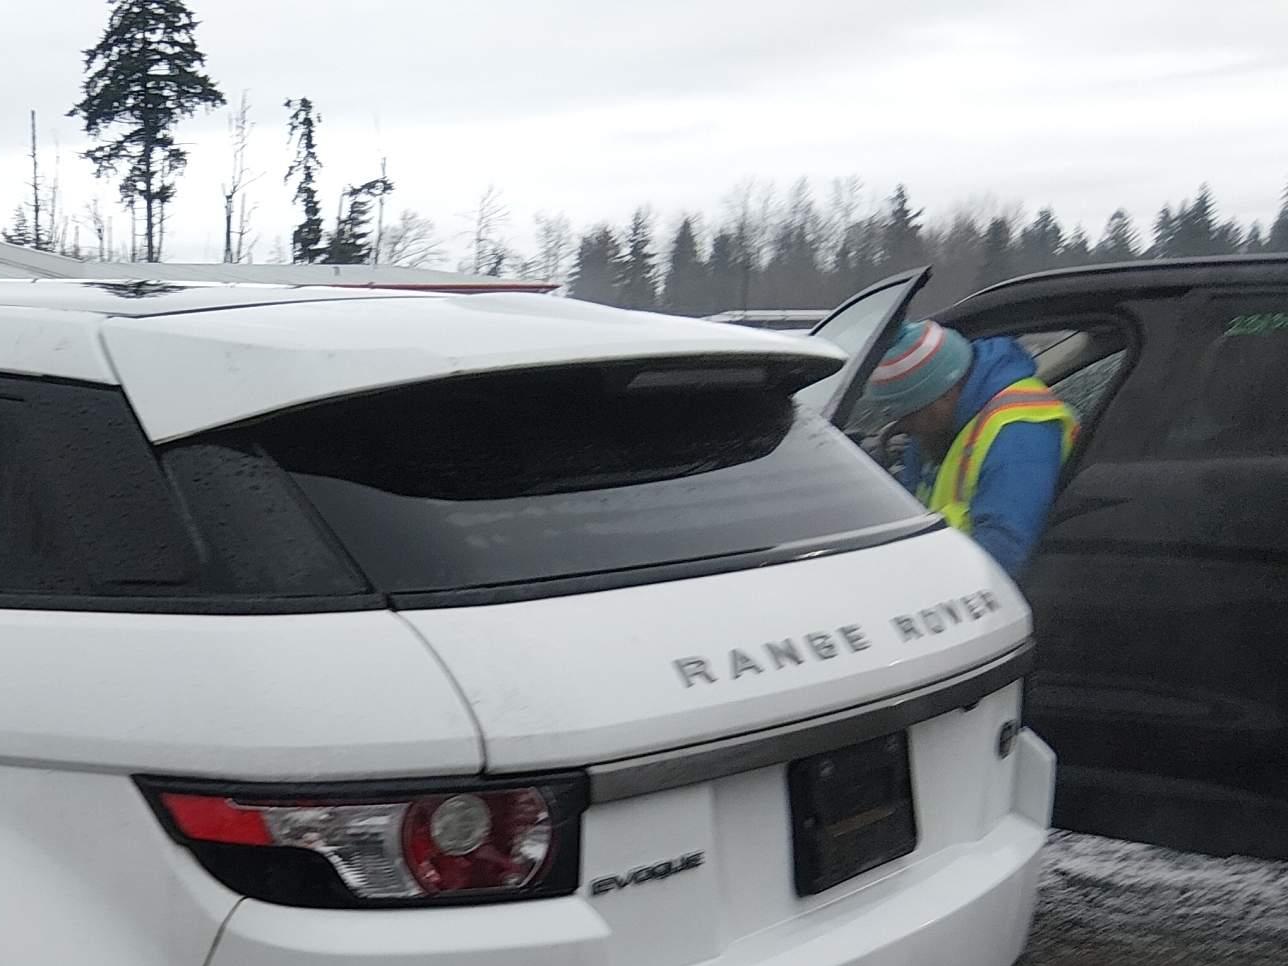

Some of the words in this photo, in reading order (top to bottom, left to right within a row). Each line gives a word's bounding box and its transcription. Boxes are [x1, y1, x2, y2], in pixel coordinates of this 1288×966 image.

[672, 624, 873, 688] RANGE
[890, 588, 1002, 643] ROVER
[590, 849, 705, 897] EVOQUE
